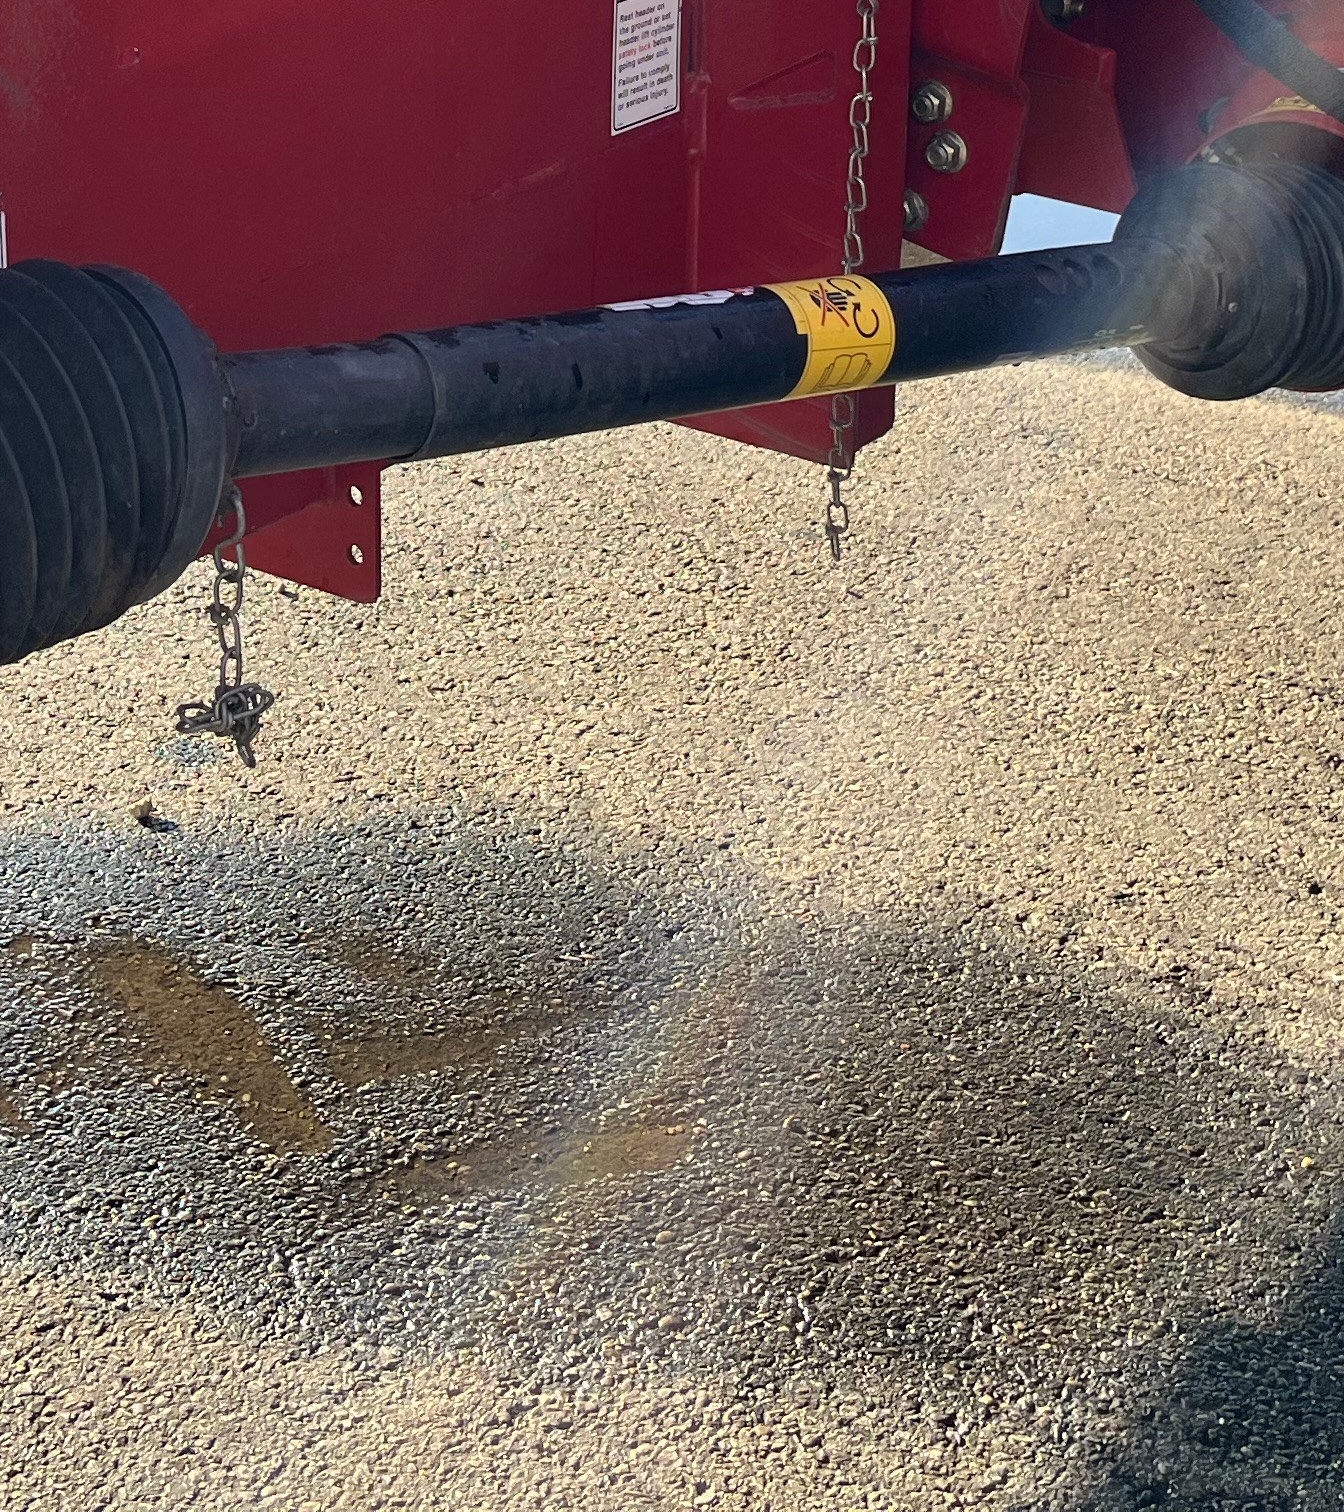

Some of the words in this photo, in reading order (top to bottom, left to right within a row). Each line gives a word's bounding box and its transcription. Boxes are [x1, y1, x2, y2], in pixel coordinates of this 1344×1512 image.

[635, 6, 656, 19] header
[657, 2, 665, 11] on
[619, 24, 630, 36] the
[631, 17, 653, 34] ground
[654, 15, 661, 24] or
[662, 11, 672, 21] set
[619, 35, 640, 47] header
[651, 23, 675, 38] cylinder
[653, 35, 672, 48] before
[618, 59, 636, 74] going
[637, 53, 655, 66] under
[618, 73, 639, 88] Failure
[641, 71, 648, 80] to
[648, 63, 671, 78] comply
[630, 82, 648, 96] result
[649, 79, 655, 88] in
[657, 73, 674, 86] death
[617, 102, 624, 112] or
[626, 94, 649, 108] serious
